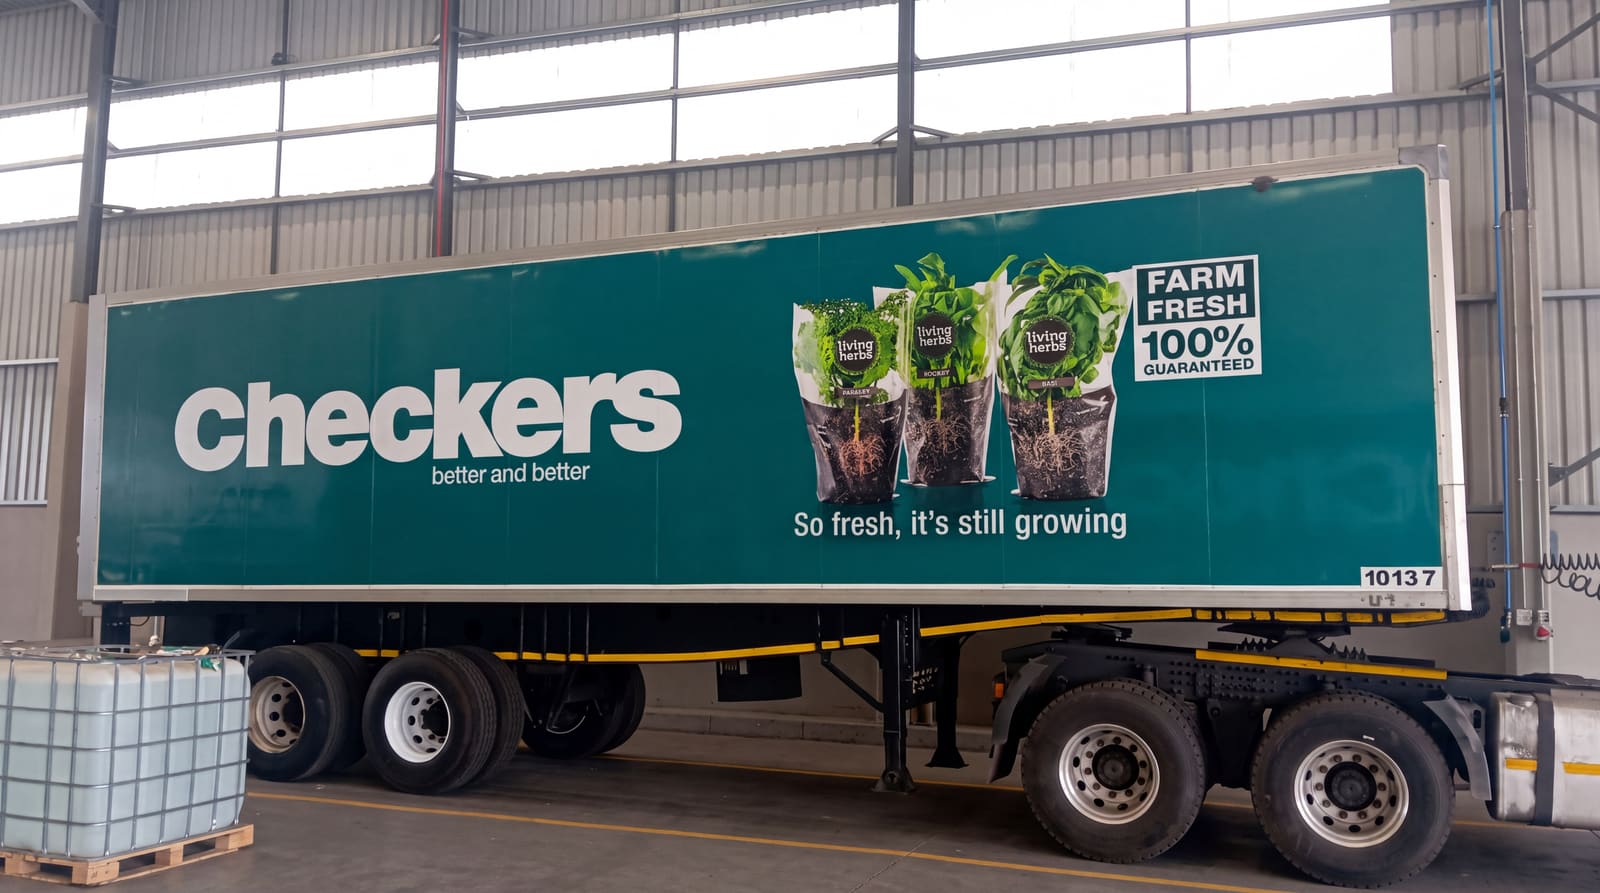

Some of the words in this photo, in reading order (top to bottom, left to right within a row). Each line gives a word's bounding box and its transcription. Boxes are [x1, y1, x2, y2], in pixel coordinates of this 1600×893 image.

[1147, 263, 1245, 294] FARM
[1147, 293, 1247, 321] FRESH
[916, 325, 952, 337] living
[1026, 331, 1067, 343] living
[838, 340, 874, 352] living
[919, 335, 952, 347] herbs
[1029, 341, 1067, 353] herbs
[1142, 323, 1254, 360] 100%
[839, 350, 873, 361] herbs
[1144, 357, 1254, 376] GUARANTEED
[174, 367, 682, 473] checkers
[432, 465, 487, 485] better
[490, 464, 527, 483] and
[532, 462, 591, 483] better
[794, 510, 824, 537] So
[832, 511, 901, 540] fresh,
[958, 508, 1006, 535] still
[1014, 508, 1127, 540] growing
[1365, 570, 1436, 586] 10137
